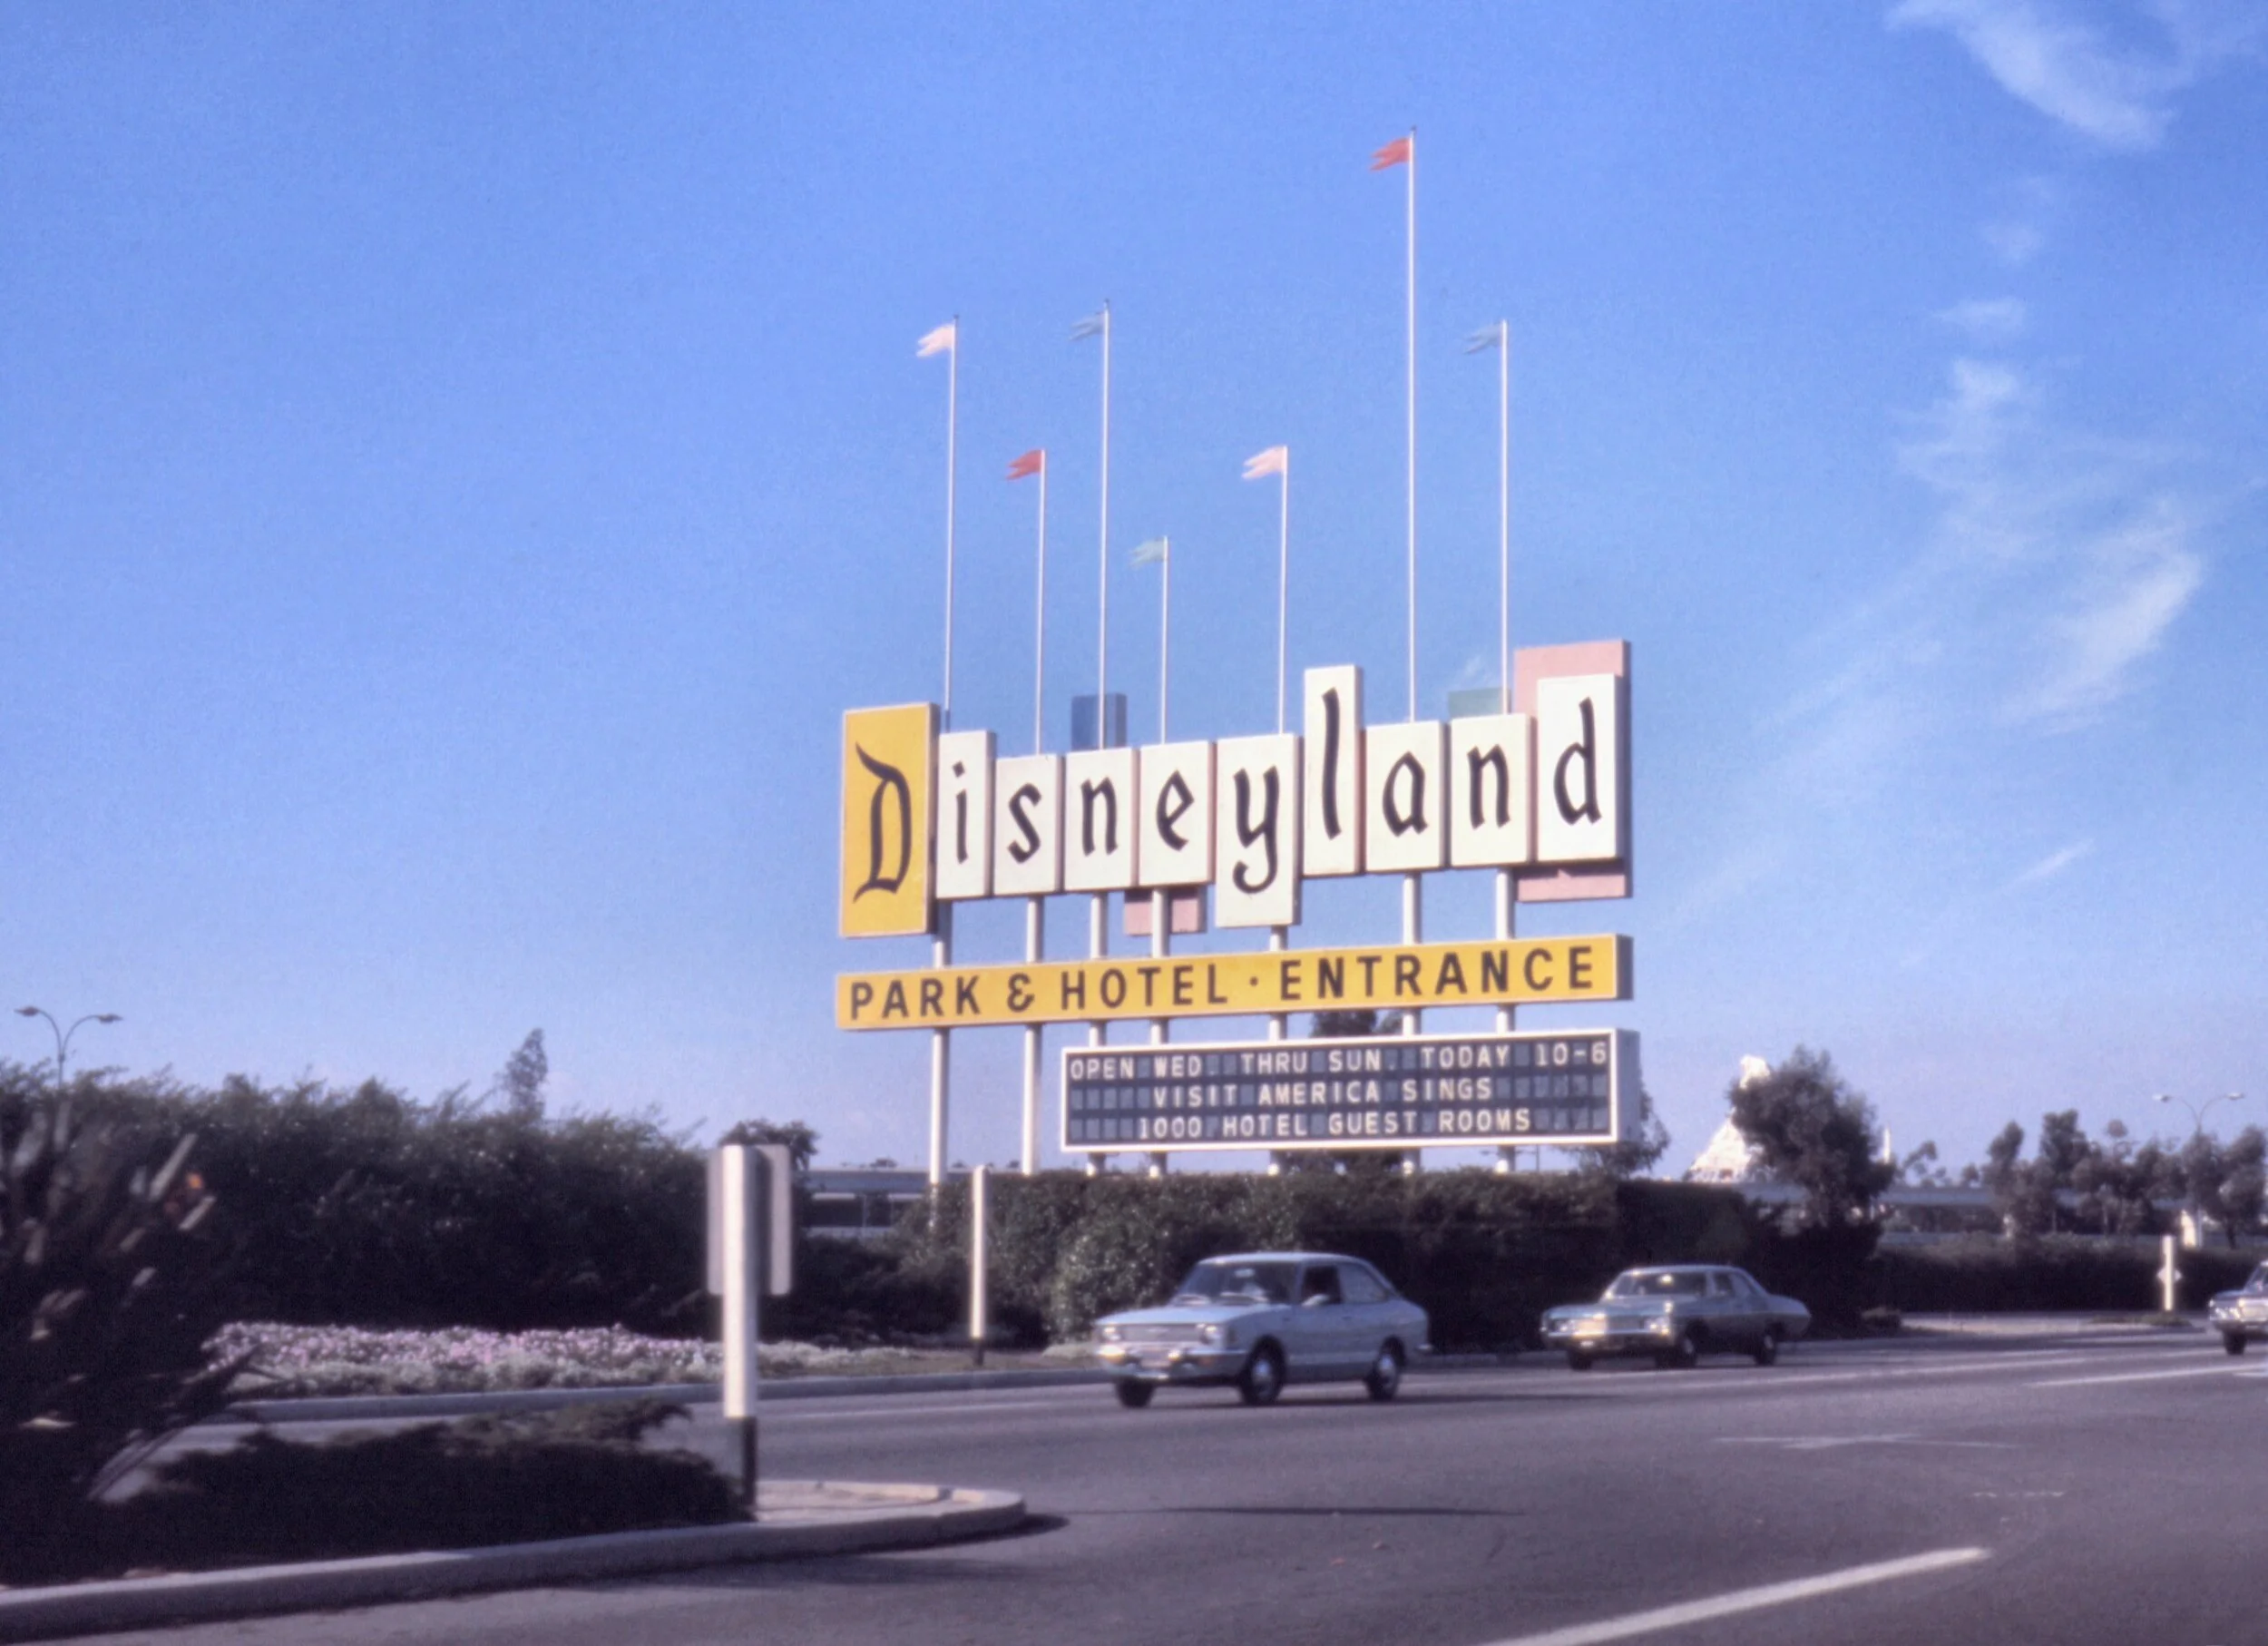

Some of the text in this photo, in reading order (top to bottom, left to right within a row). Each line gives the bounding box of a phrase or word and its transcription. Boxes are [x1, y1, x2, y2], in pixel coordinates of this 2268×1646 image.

[853, 687, 1603, 904] Disneyland
[850, 975, 981, 1021] PARK
[1006, 972, 1035, 1014] &
[1061, 963, 1228, 1011] HOTEL
[1279, 945, 1593, 1001] ENTRANCE
[1070, 1055, 1134, 1081] OPEN
[1240, 1051, 1307, 1074] THRU
[1420, 1044, 1510, 1069] TODAY
[1535, 1041, 1608, 1066] 10-6
[1153, 1076, 1492, 1108] VISIT AMERICA SINGS
[1138, 1107, 1531, 1140] 1000 HOTEL GUEST ROOMS
